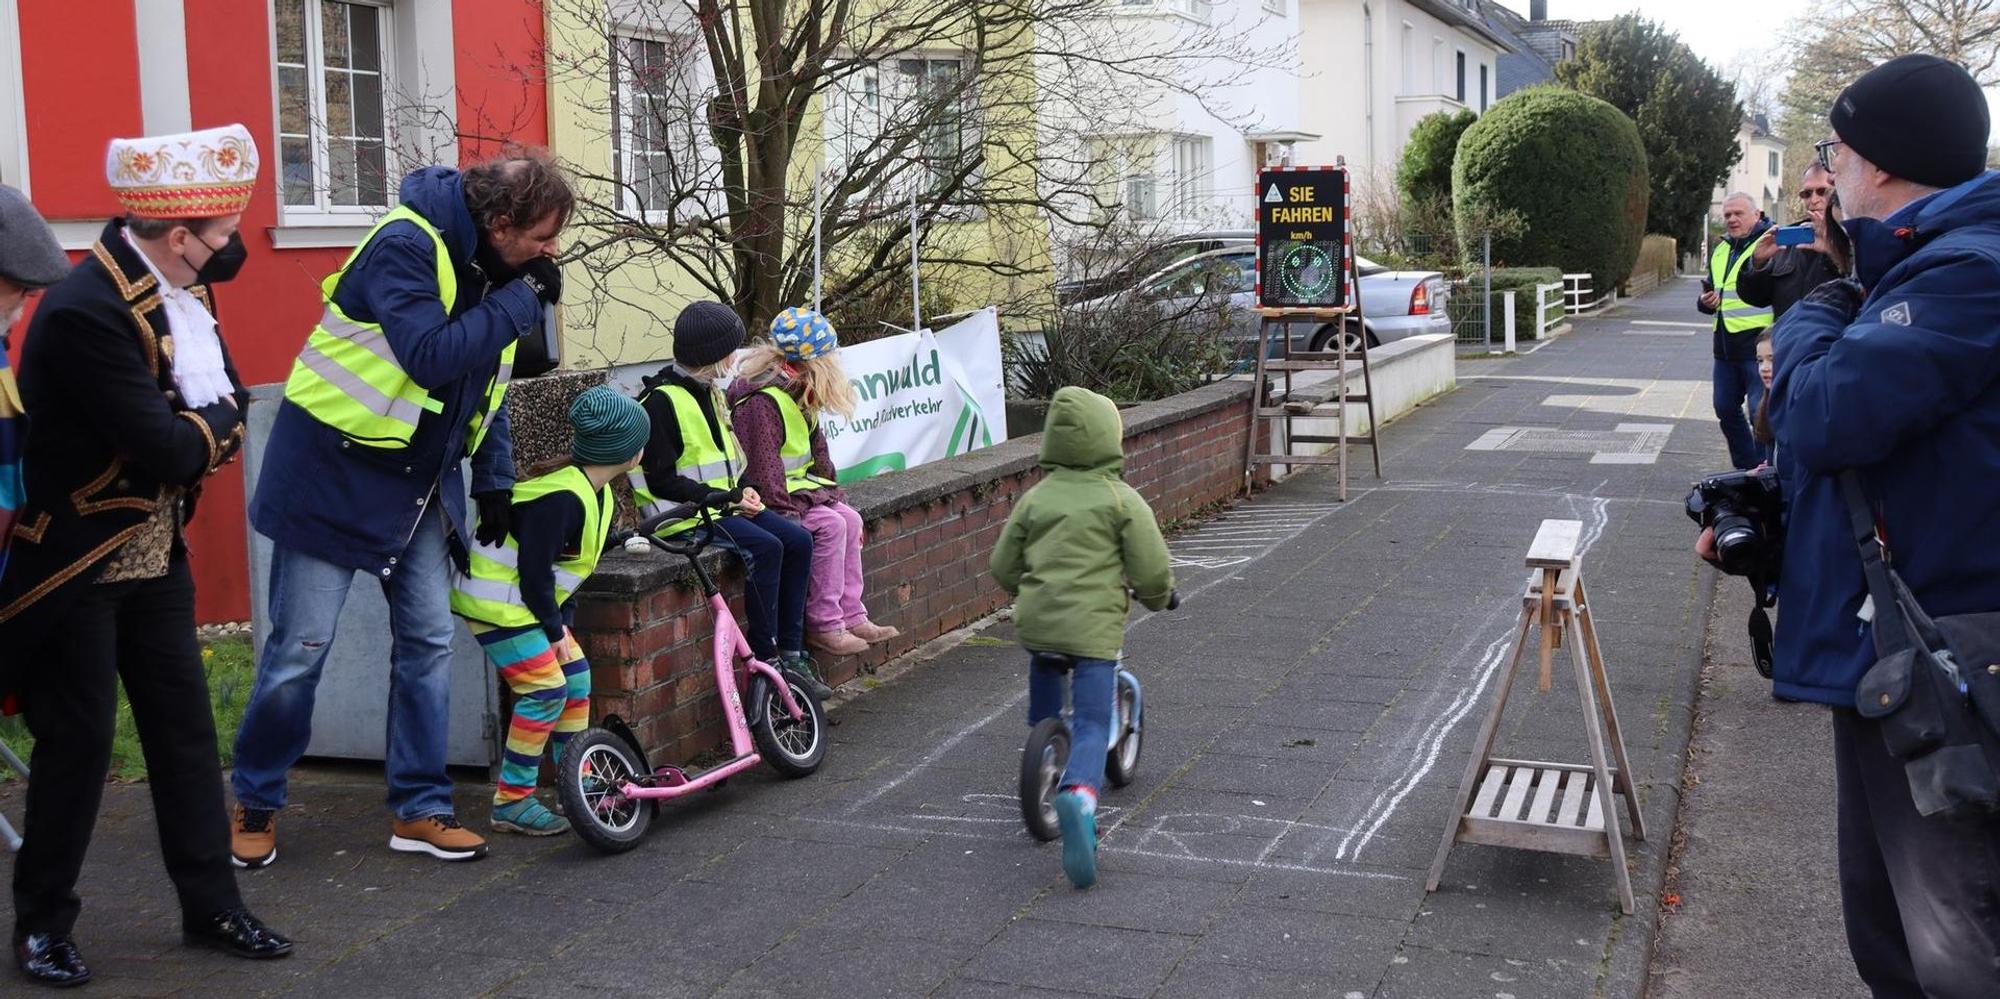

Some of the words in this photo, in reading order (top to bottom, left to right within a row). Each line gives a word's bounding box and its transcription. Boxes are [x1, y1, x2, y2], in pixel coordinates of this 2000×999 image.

[1289, 186, 1315, 202] SIE
[1272, 206, 1333, 223] FAHREN
[1290, 231, 1313, 241] km/h
[849, 349, 942, 402] nnwald
[851, 411, 880, 433] und
